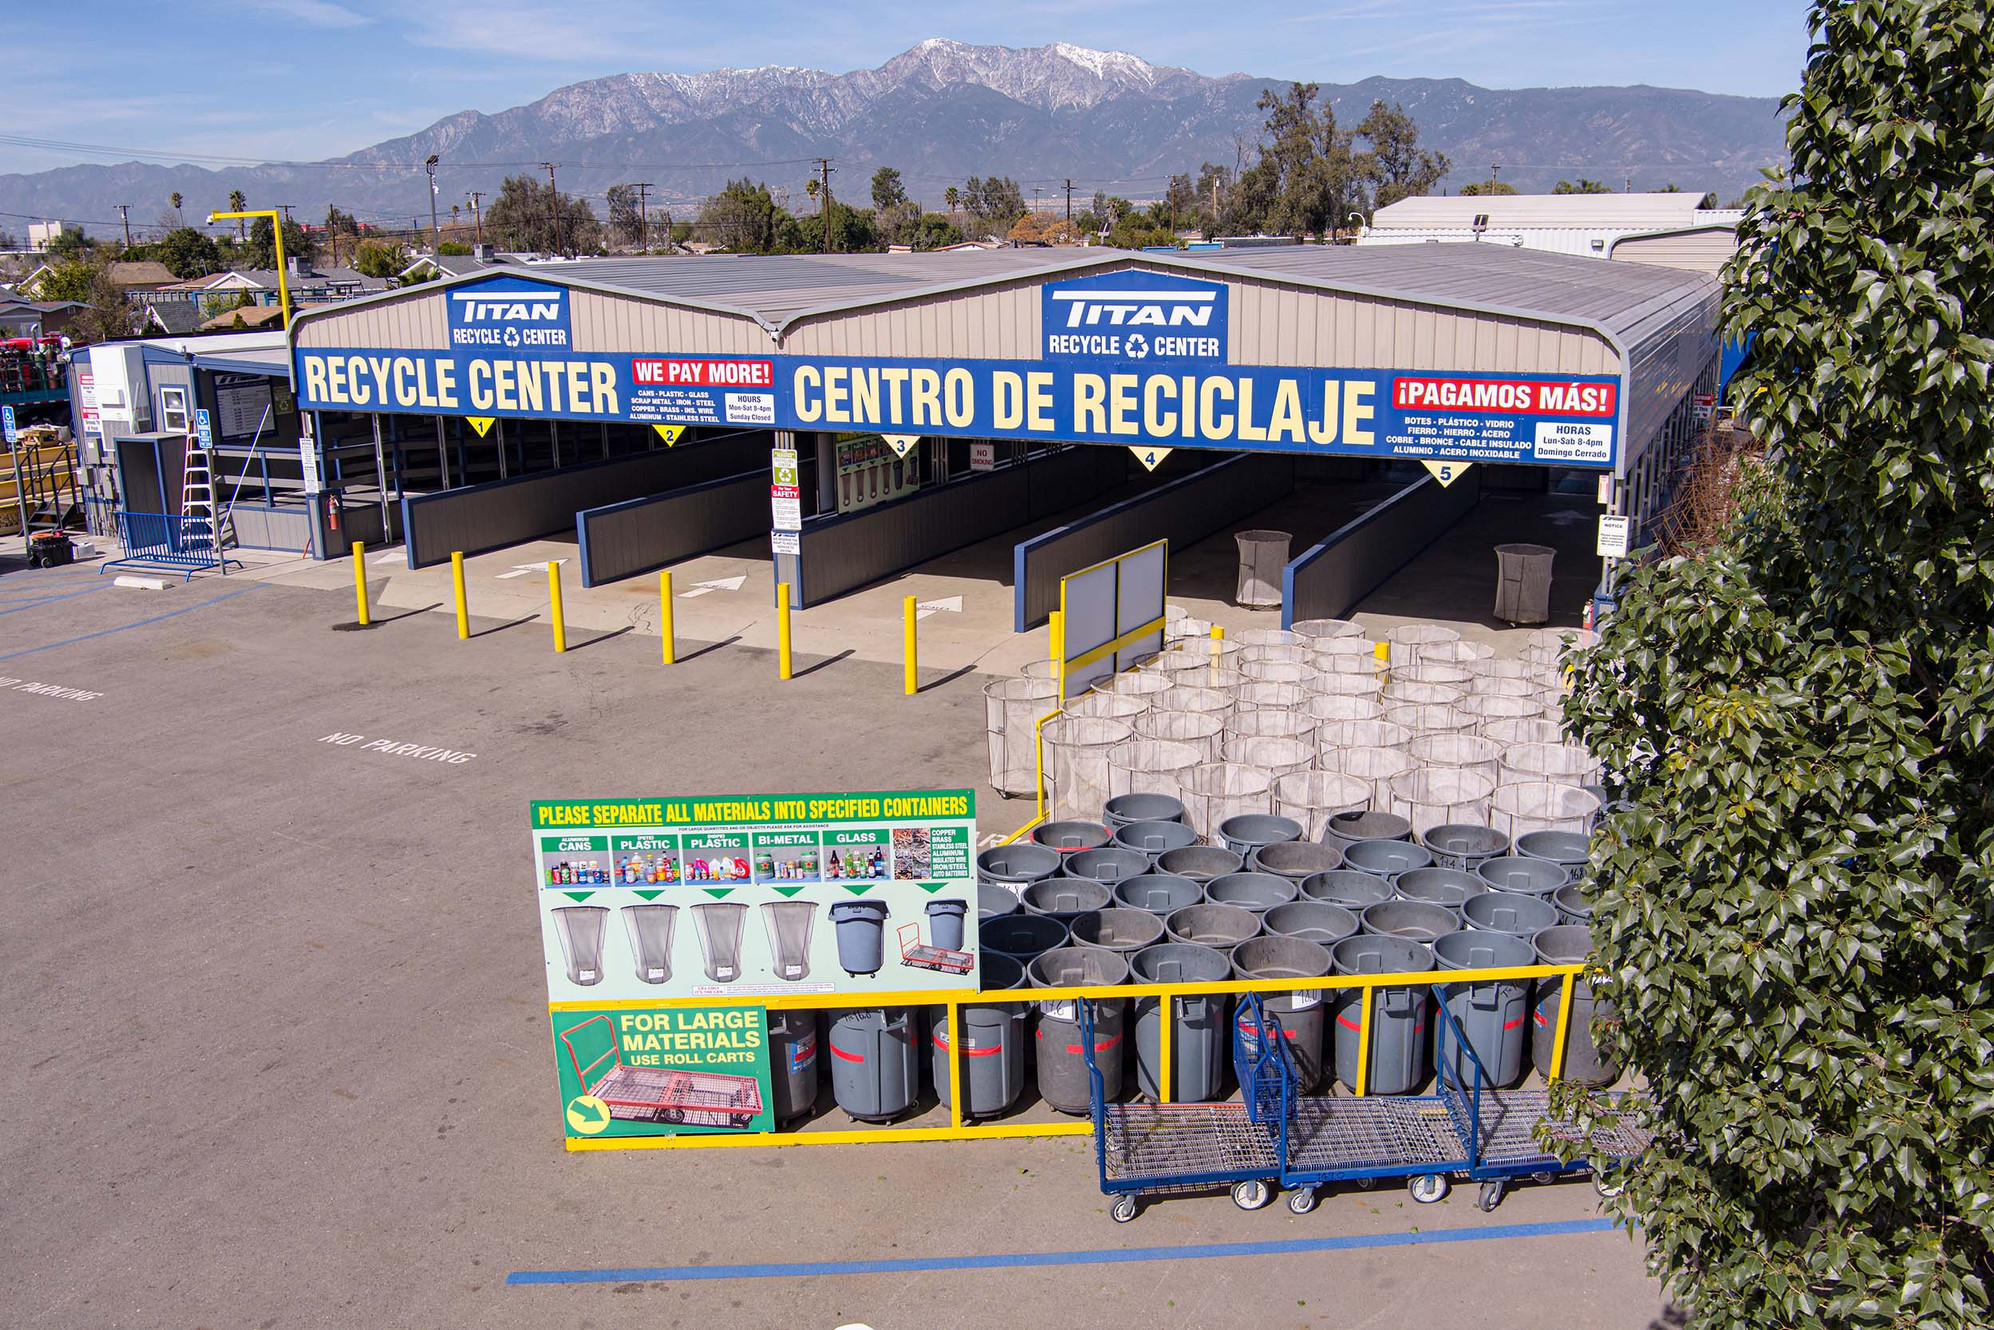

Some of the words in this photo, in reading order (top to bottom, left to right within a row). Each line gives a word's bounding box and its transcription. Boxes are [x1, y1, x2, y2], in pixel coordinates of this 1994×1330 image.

[453, 292, 561, 322] TITAN
[1052, 290, 1217, 328] TITAN
[453, 328, 501, 344] RECYCLE
[522, 329, 567, 345] CENTER
[1049, 335, 1120, 355] RECYCLE
[1154, 336, 1219, 357] CENTER
[635, 362, 664, 382] WE
[668, 362, 702, 382] PAY
[708, 363, 770, 384] MORE!
[304, 355, 459, 408] RECYCLE
[468, 358, 620, 414] CENTER
[737, 395, 761, 403] HOURS
[1398, 382, 1532, 409] ¡PAGAMOS
[1539, 382, 1607, 412] MÁS!
[793, 365, 975, 428] CENTRO
[992, 370, 1055, 432] DE
[1073, 372, 1376, 446] RECICLAJE
[730, 413, 750, 421] Sunday
[1404, 417, 1432, 425] BOTES
[1438, 417, 1479, 427] PLÁSTICO
[1485, 420, 1514, 428] VIDRIO
[478, 421, 484, 432] 1
[1407, 427, 1437, 435] FIERRO
[1444, 428, 1477, 437] HIERRO
[1481, 430, 1510, 438] ACERO
[1556, 425, 1591, 435] HORAS
[666, 430, 674, 442] 2
[1543, 436, 1575, 445] Lun-Sab
[1577, 438, 1603, 448] 8-4pm
[896, 440, 905, 452] 3
[1420, 437, 1453, 446] BRONCE
[1460, 439, 1487, 447] CABLE
[1489, 440, 1532, 449] INSULADO
[1145, 451, 1155, 465] 4
[1393, 446, 1433, 454] ALUMINIO
[1439, 448, 1468, 456] ACERO
[1469, 449, 1520, 458] INOXIDABLE
[1538, 447, 1573, 458] Domingo
[1575, 449, 1607, 458] Cerrado
[1440, 466, 1451, 481] 5
[773, 490, 798, 498] SAFETY
[12, 682, 104, 701] PARKING
[317, 732, 364, 745] NO
[360, 739, 477, 764] PARKING
[538, 805, 591, 825] PLEASE
[593, 803, 663, 824] SEPARATE
[665, 803, 691, 822] ALL
[693, 800, 771, 821] MATERIALS
[774, 800, 806, 820] INTO
[809, 798, 880, 819] SPECIFIED
[883, 796, 968, 817] CONTAINERS
[691, 838, 741, 848] PLASTIC
[758, 835, 814, 845] BI-METAL
[836, 833, 876, 843] GLASS
[558, 841, 592, 851] CANS
[620, 840, 670, 849] PLASTIC
[620, 1013, 670, 1032] FOR
[678, 1011, 760, 1030] LARGE
[623, 1030, 761, 1051] MATERIALS
[630, 1054, 660, 1066] USE
[664, 1053, 703, 1065] ROLL
[706, 1051, 755, 1063] CARTS
